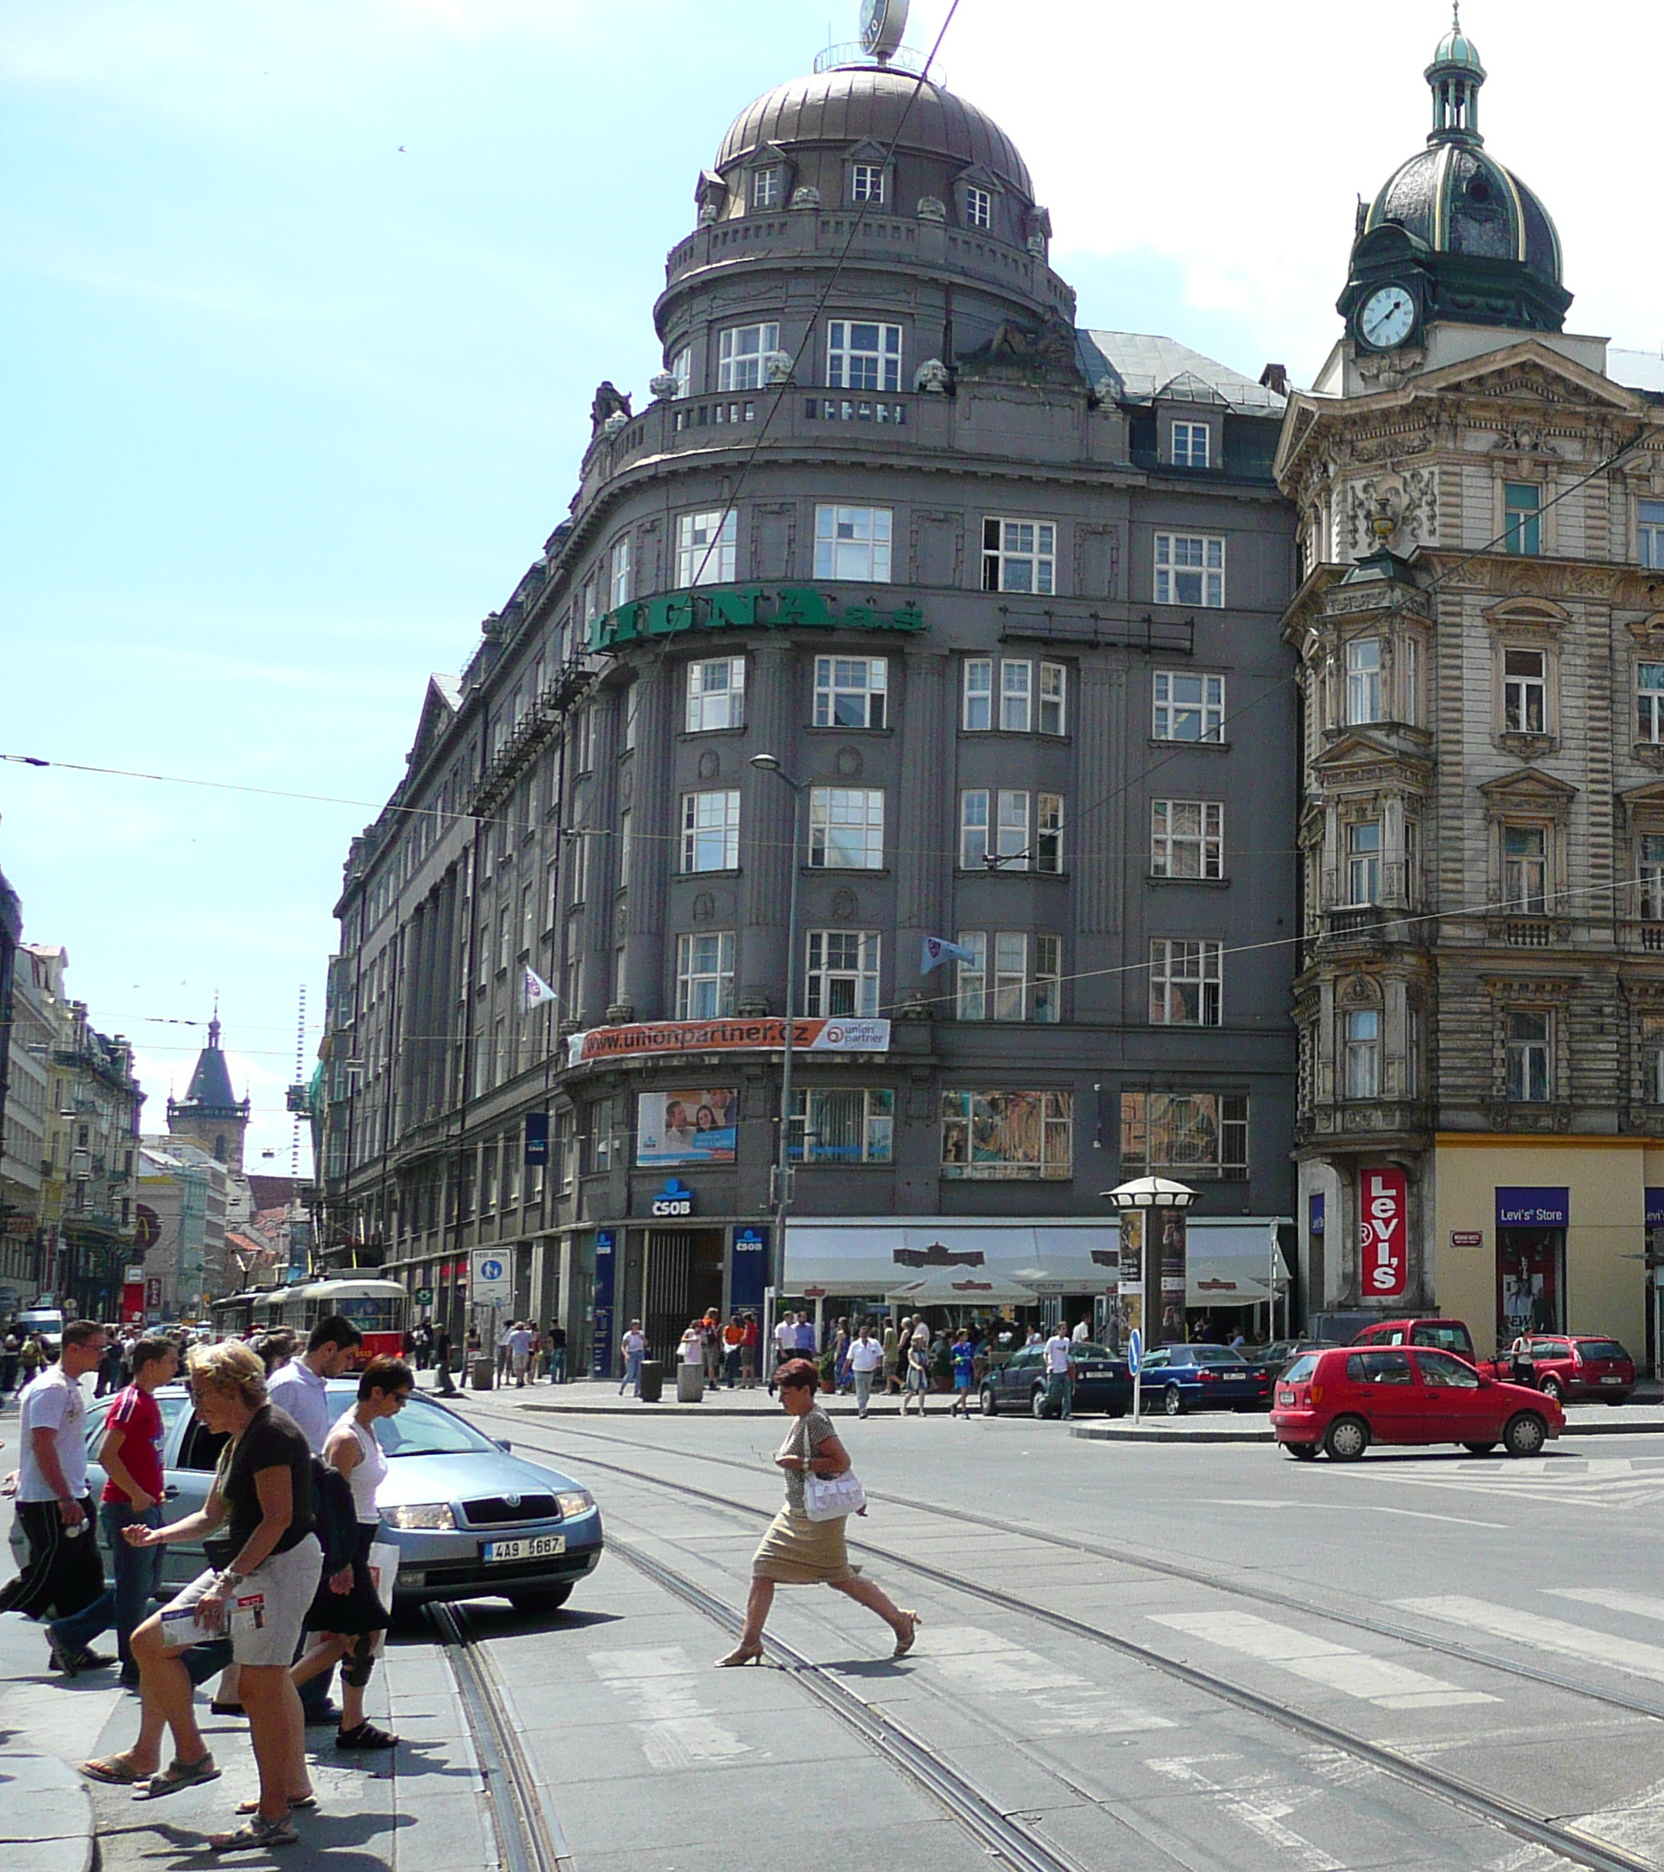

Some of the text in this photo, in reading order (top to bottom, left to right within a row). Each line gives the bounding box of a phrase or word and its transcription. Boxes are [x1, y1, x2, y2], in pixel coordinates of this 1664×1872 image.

[589, 588, 839, 653] LIGNA
[586, 1020, 809, 1053] www.unionpartner.cz
[845, 1024, 875, 1035] union
[845, 1034, 883, 1044] partner
[652, 1201, 691, 1216] ČSOB
[1536, 1208, 1563, 1221] Store
[496, 1543, 520, 1558] 4A9
